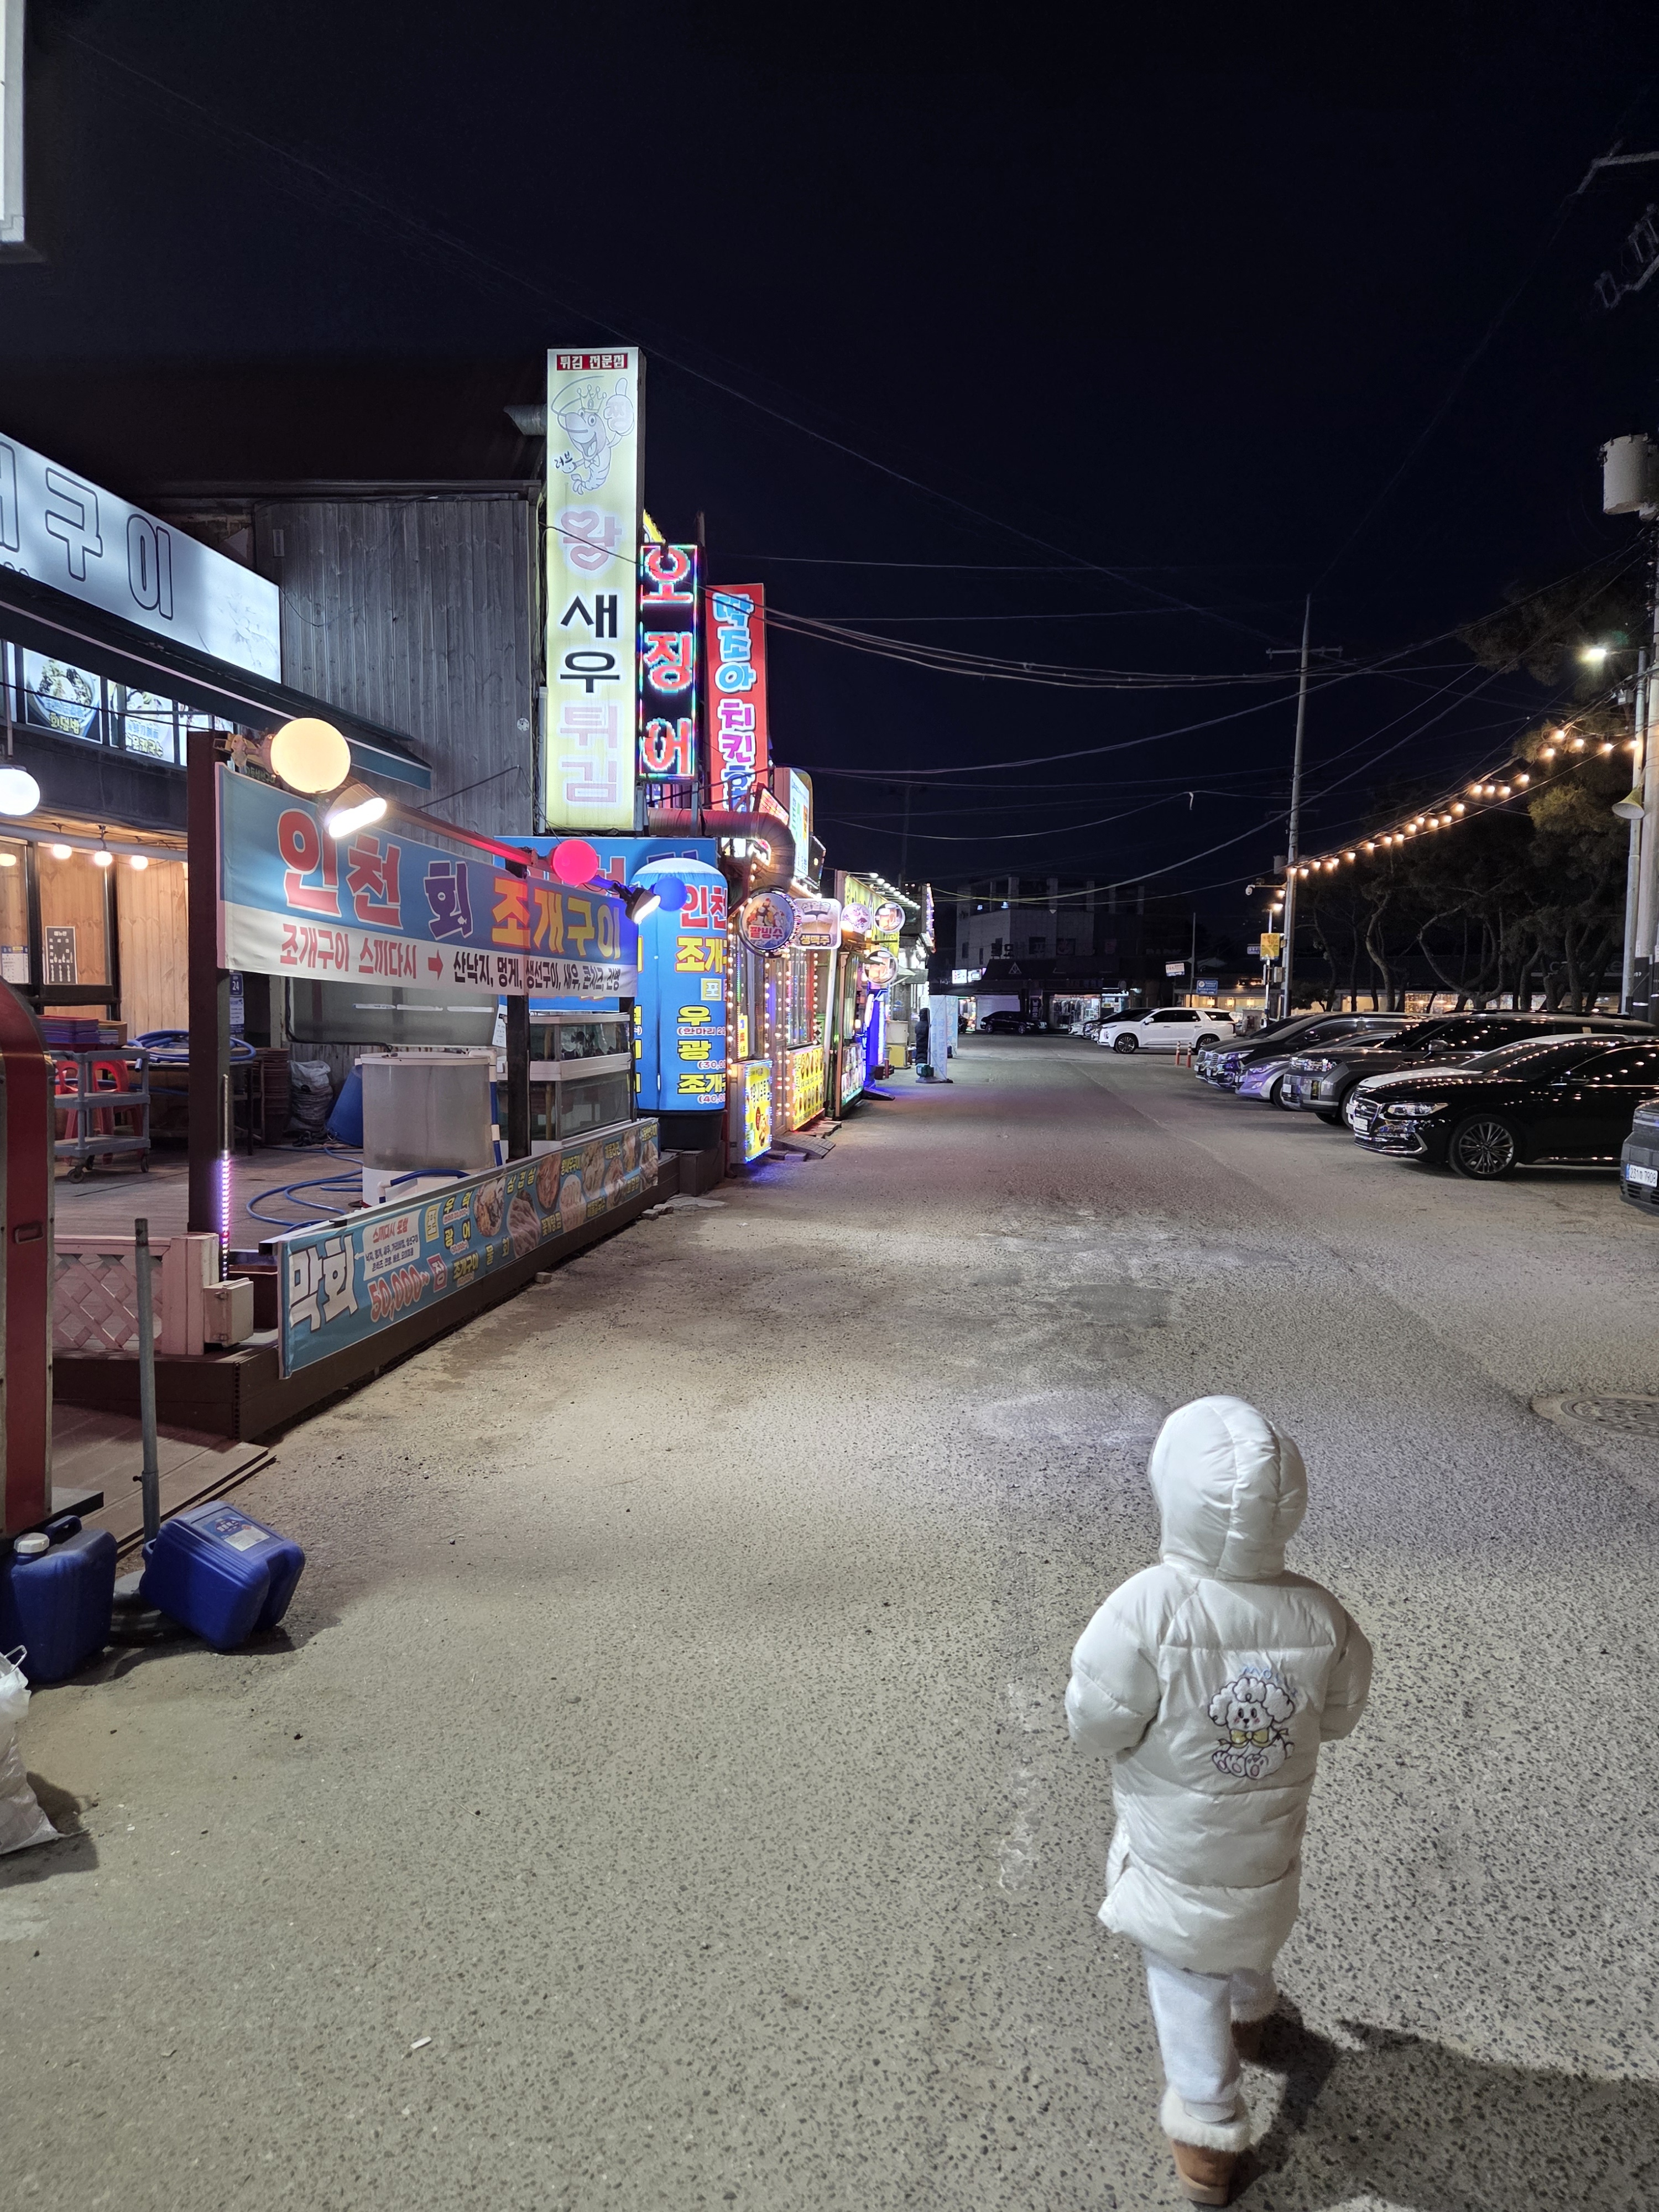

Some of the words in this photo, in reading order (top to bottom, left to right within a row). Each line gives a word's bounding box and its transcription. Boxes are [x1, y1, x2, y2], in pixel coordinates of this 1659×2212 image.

[560, 356, 582, 369] 튀김
[589, 354, 624, 369] 전문점
[560, 510, 622, 804] 왕새우튀김
[641, 545, 693, 775] 오징어
[278, 808, 404, 930] 인천
[424, 860, 474, 940] 회
[491, 877, 621, 961] 조개구이
[680, 885, 727, 930] 인천
[750, 926, 783, 939] 팥빙수
[801, 935, 830, 946] 생맥주
[280, 923, 349, 972] 조개구이
[358, 937, 417, 979] 스끼다시
[453, 951, 493, 988] 산낙지,
[497, 957, 522, 989] 멍게,
[526, 960, 561, 990] 생선구이,
[563, 963, 581, 990] 새우,
[232, 980, 239, 990] 24
[705, 982, 719, 998] 포
[677, 1005, 712, 1026] 우
[677, 1040, 712, 1061] 광
[507, 1167, 537, 1194] 삼겹살
[427, 1209, 437, 1237] 포
[289, 1232, 358, 1333] 막회
[431, 1260, 445, 1285] 장
